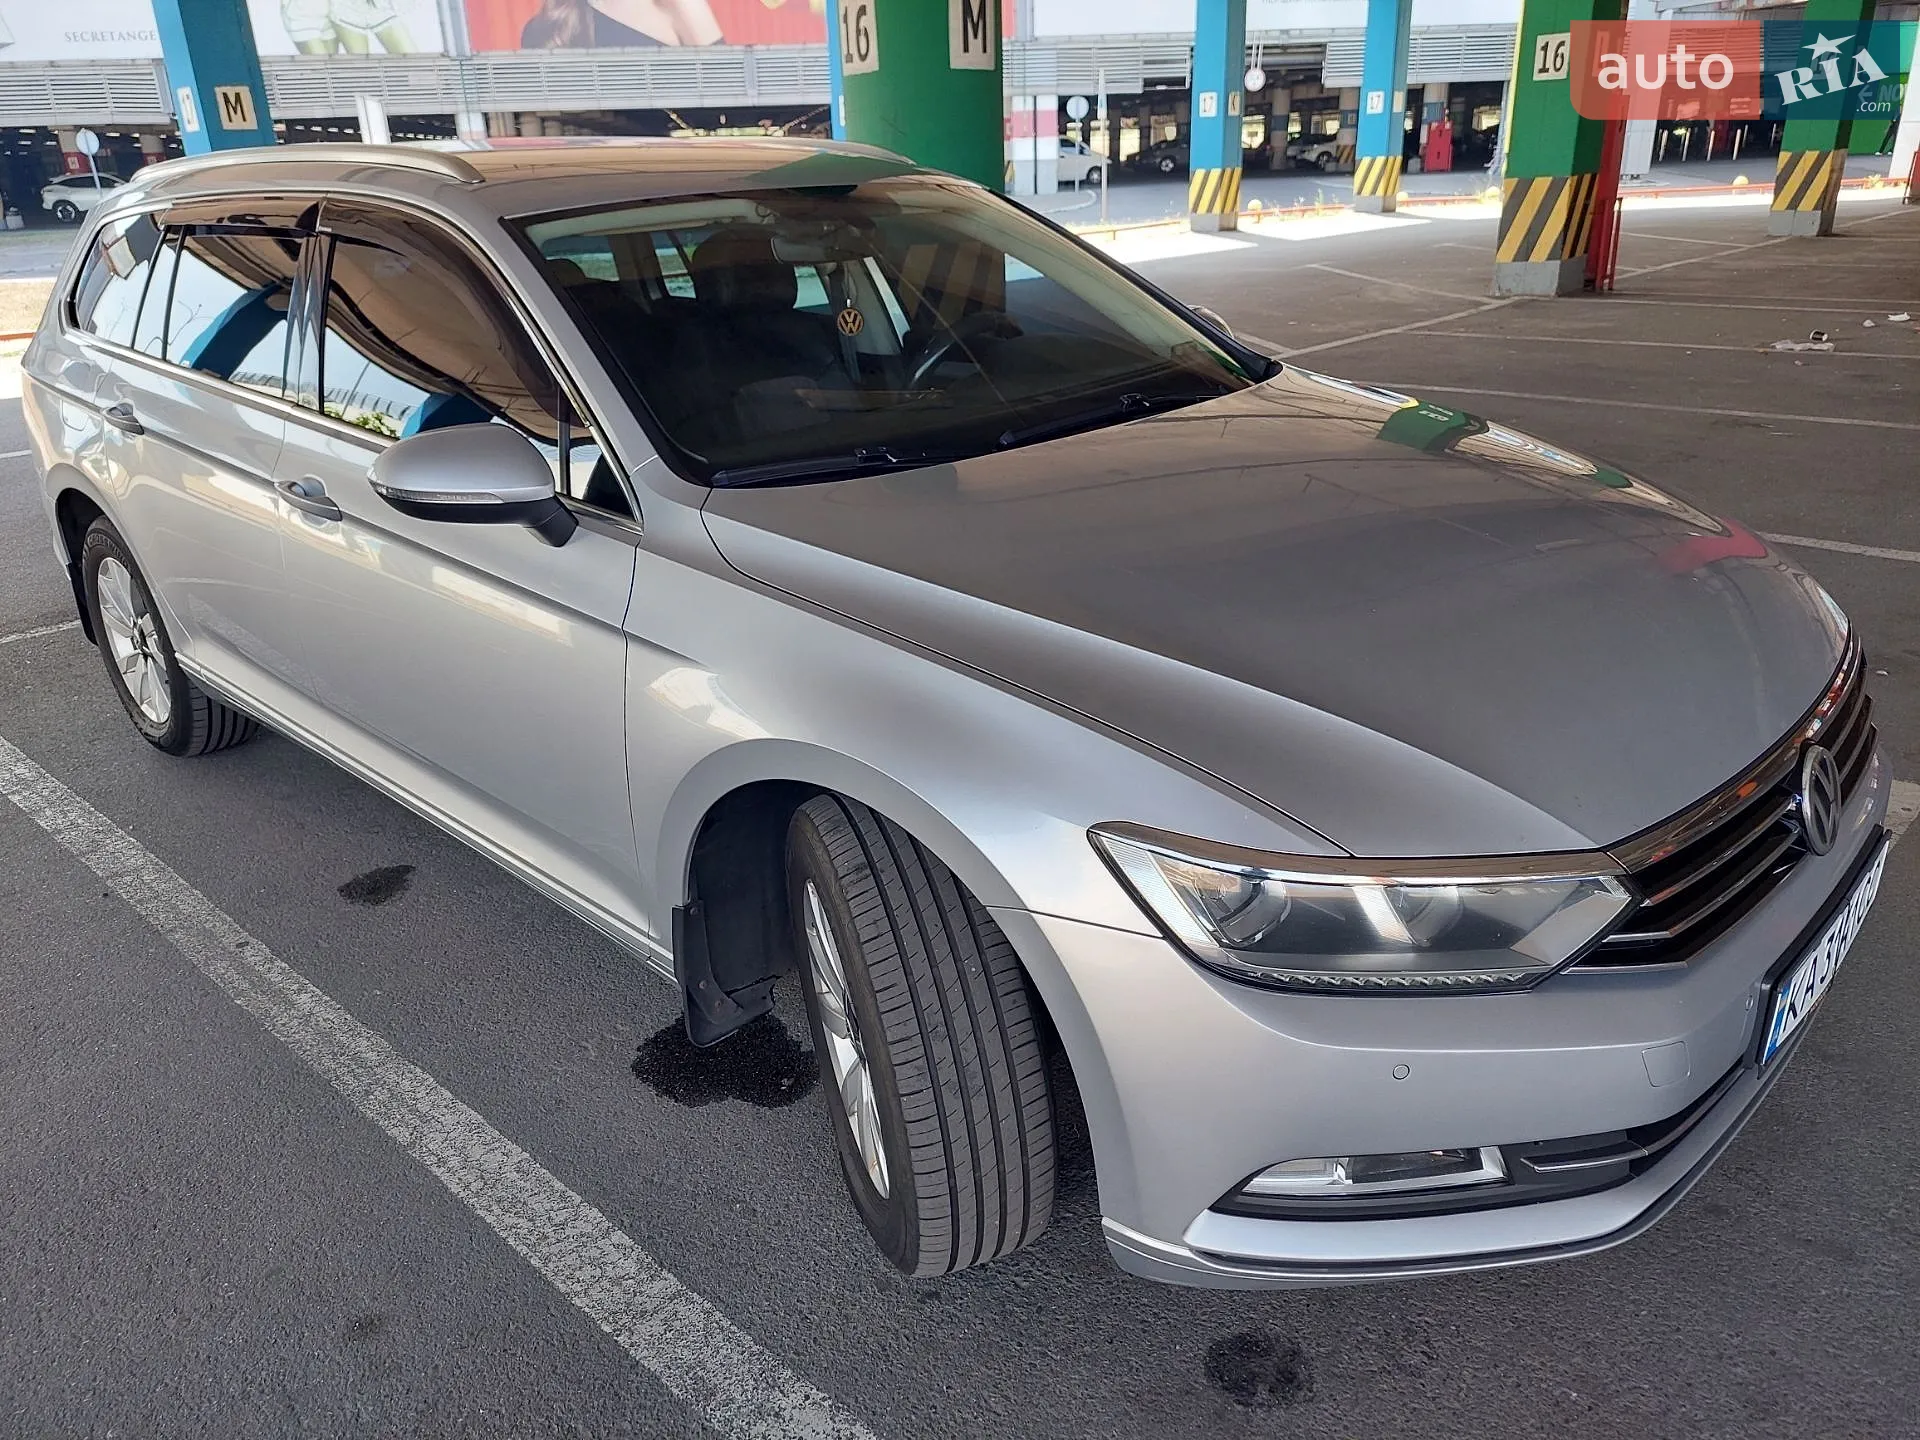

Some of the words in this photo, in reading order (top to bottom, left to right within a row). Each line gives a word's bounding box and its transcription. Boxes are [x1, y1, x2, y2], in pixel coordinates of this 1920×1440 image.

[843, 4, 870, 63] 16
[962, 0, 987, 53] M
[1538, 40, 1566, 74] 16
[222, 91, 248, 122] M
[1203, 95, 1214, 112] 17
[1370, 94, 1381, 110] 17
[1783, 955, 1818, 1032] KA
